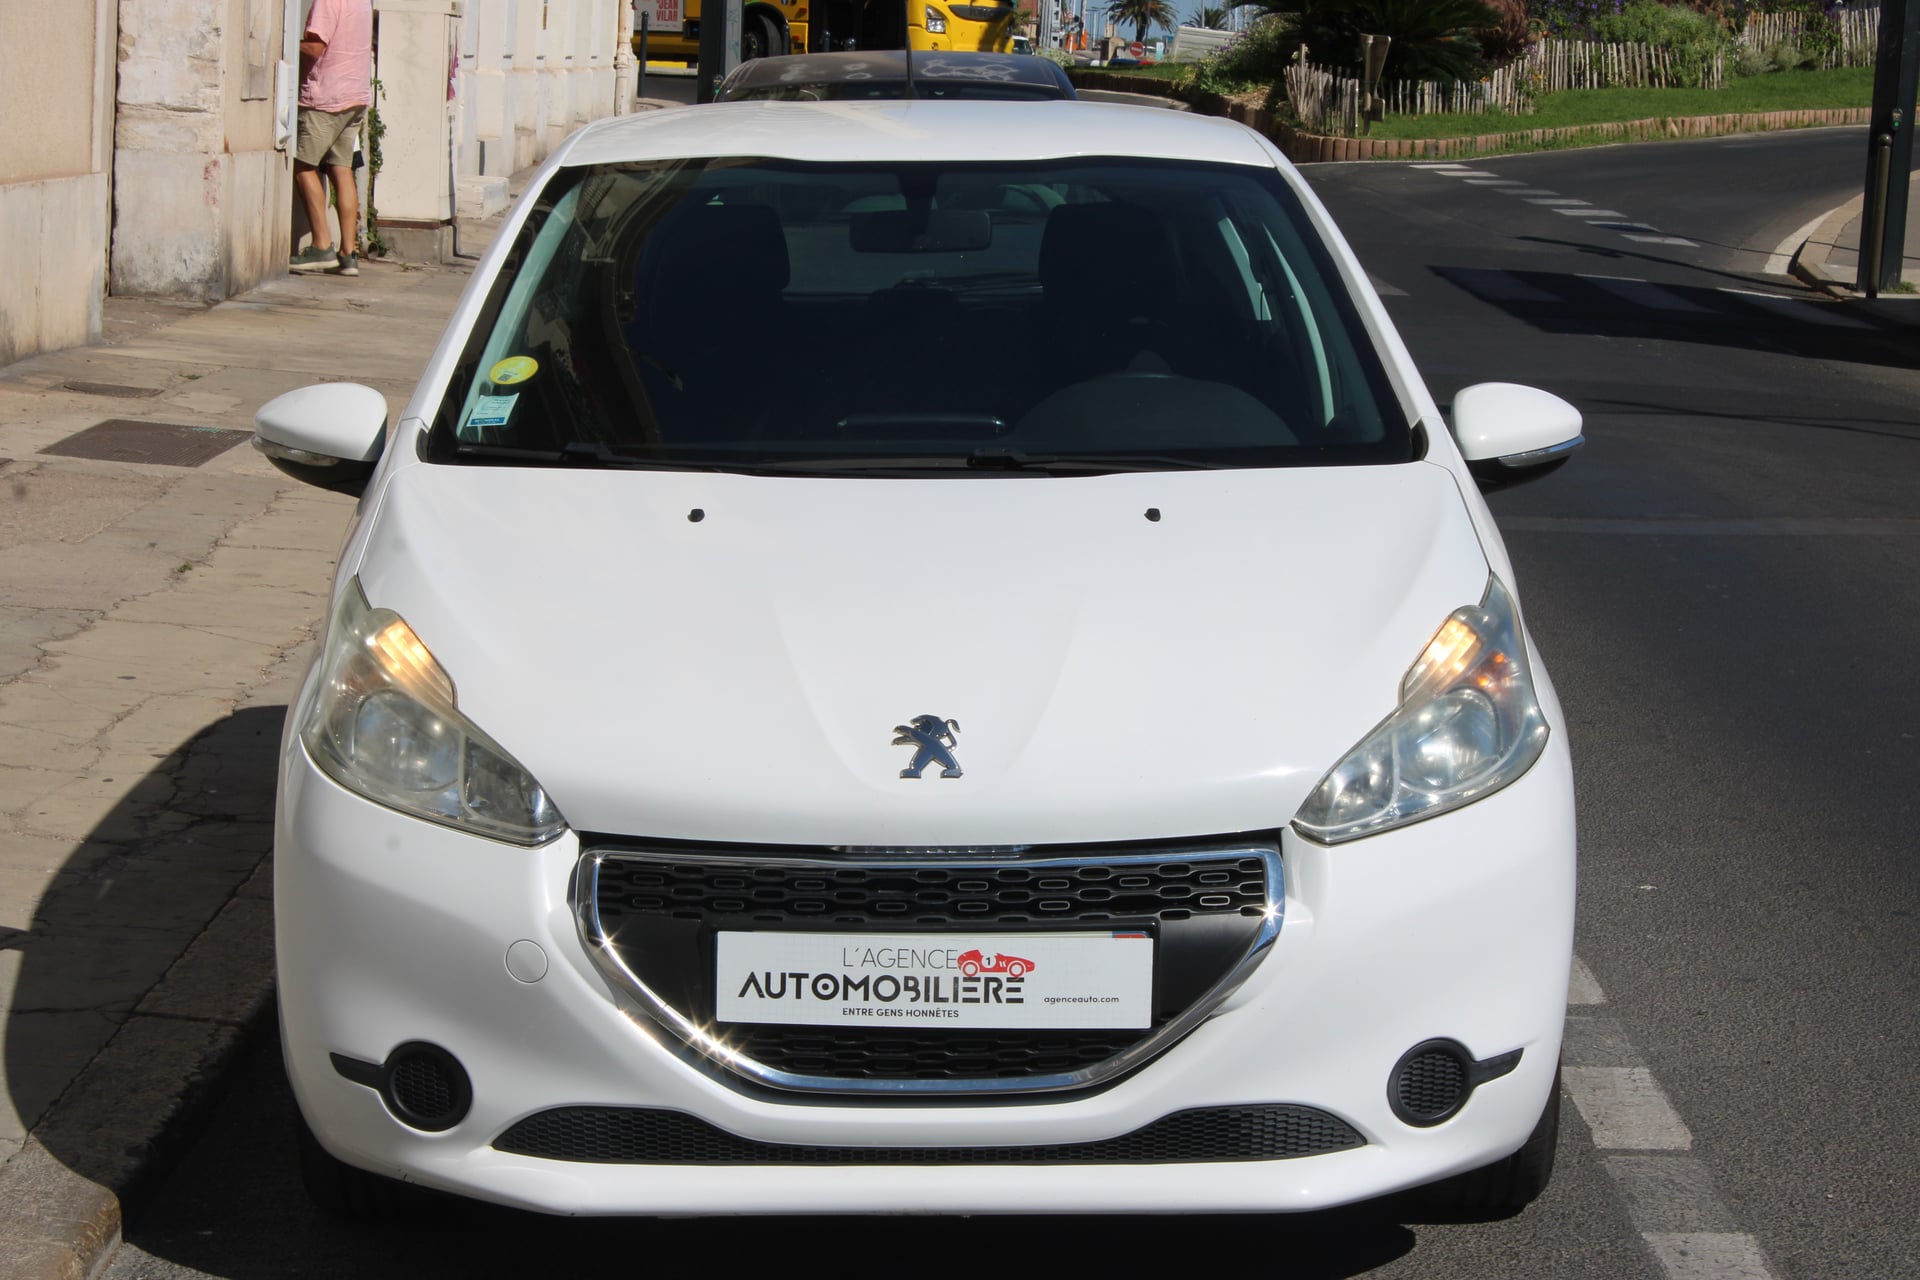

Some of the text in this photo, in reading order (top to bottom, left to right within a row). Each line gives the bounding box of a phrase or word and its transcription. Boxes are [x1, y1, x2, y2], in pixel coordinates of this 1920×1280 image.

[656, 10, 678, 22] VILAR
[843, 947, 958, 969] L'AGENCE
[1043, 995, 1120, 1005] agenceauto.com
[842, 1007, 959, 1018] ENTRE GENS HONNÊTES
